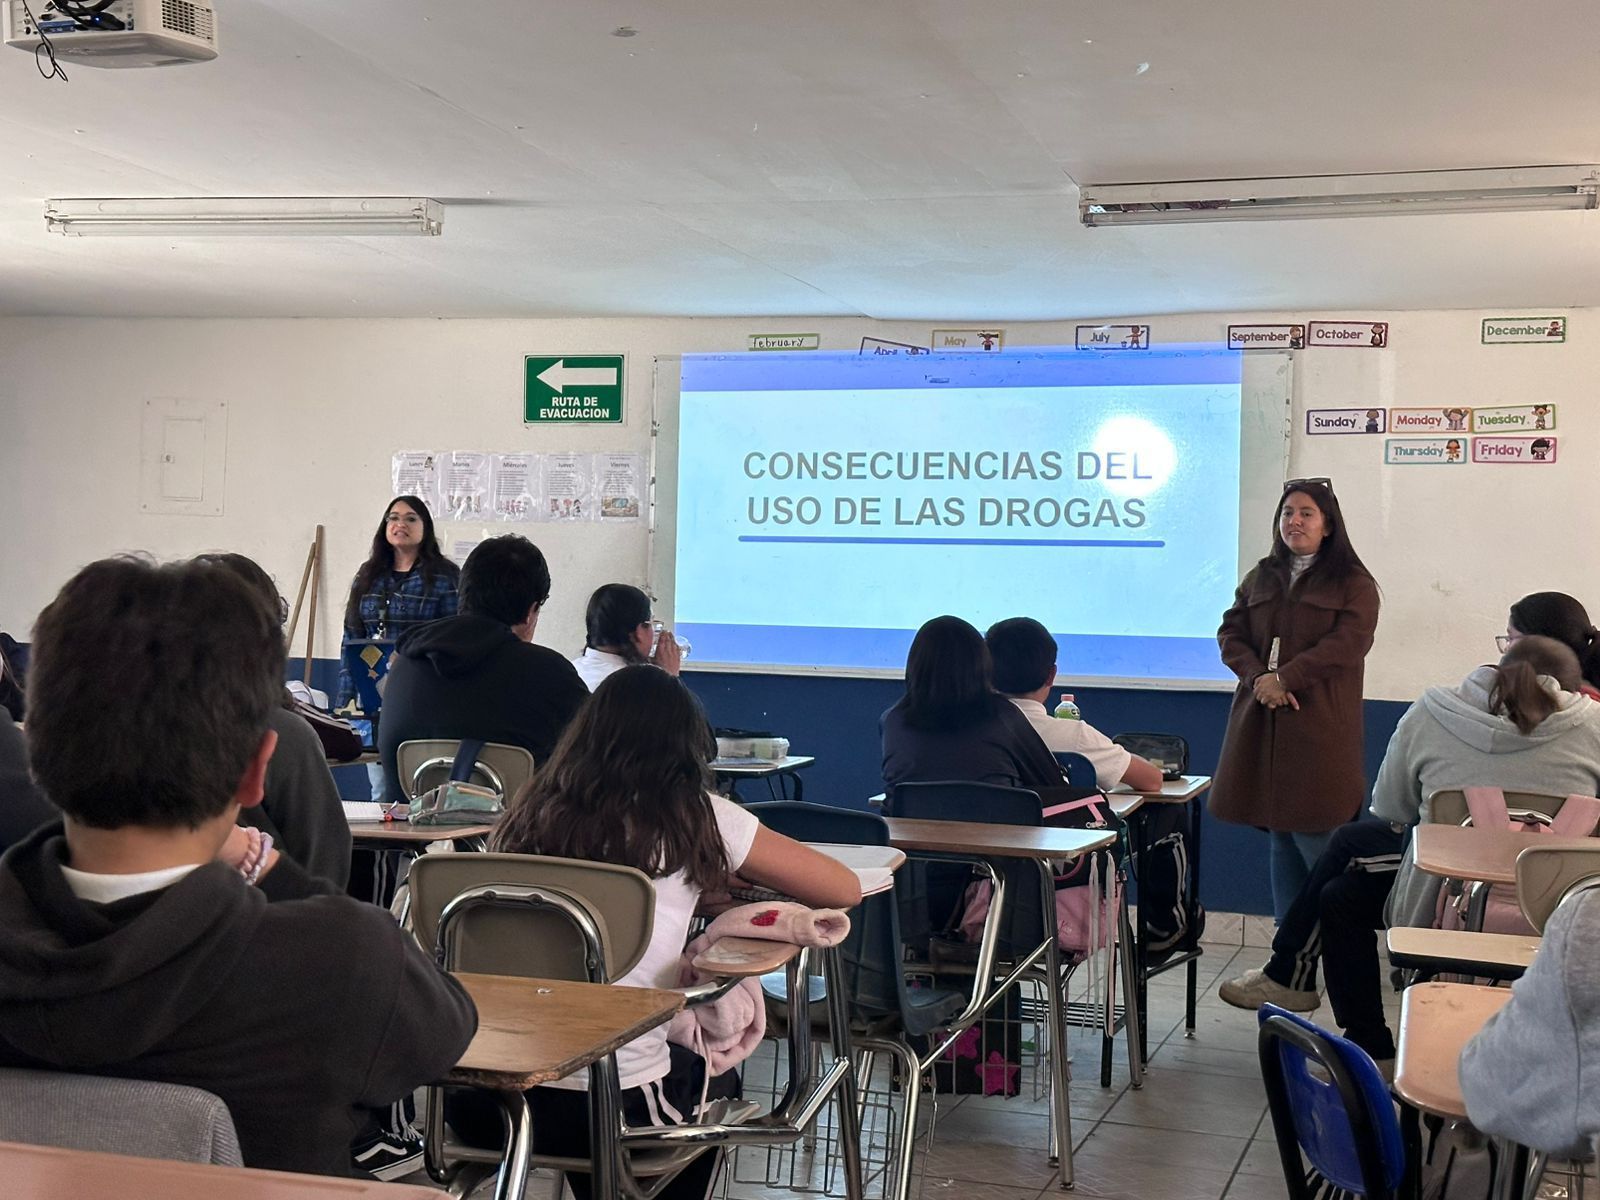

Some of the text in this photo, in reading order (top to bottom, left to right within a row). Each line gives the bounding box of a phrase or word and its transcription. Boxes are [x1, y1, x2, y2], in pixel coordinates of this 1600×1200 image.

[1316, 329, 1363, 339] October
[1487, 325, 1548, 335] December
[944, 336, 967, 348] May
[1090, 331, 1110, 343] July
[1231, 332, 1289, 343] September
[552, 397, 598, 406] RUTA DE
[540, 408, 609, 418] EVACUACION
[1314, 415, 1356, 428] Sunday
[1396, 415, 1442, 427] Monday
[1478, 413, 1526, 426] Tuesday
[1394, 445, 1444, 458] Thursday
[1481, 443, 1523, 457] Friday
[743, 450, 1153, 480] CONSECUENCIAS DEL
[748, 496, 1146, 528] USO DE LAS DROGAS
